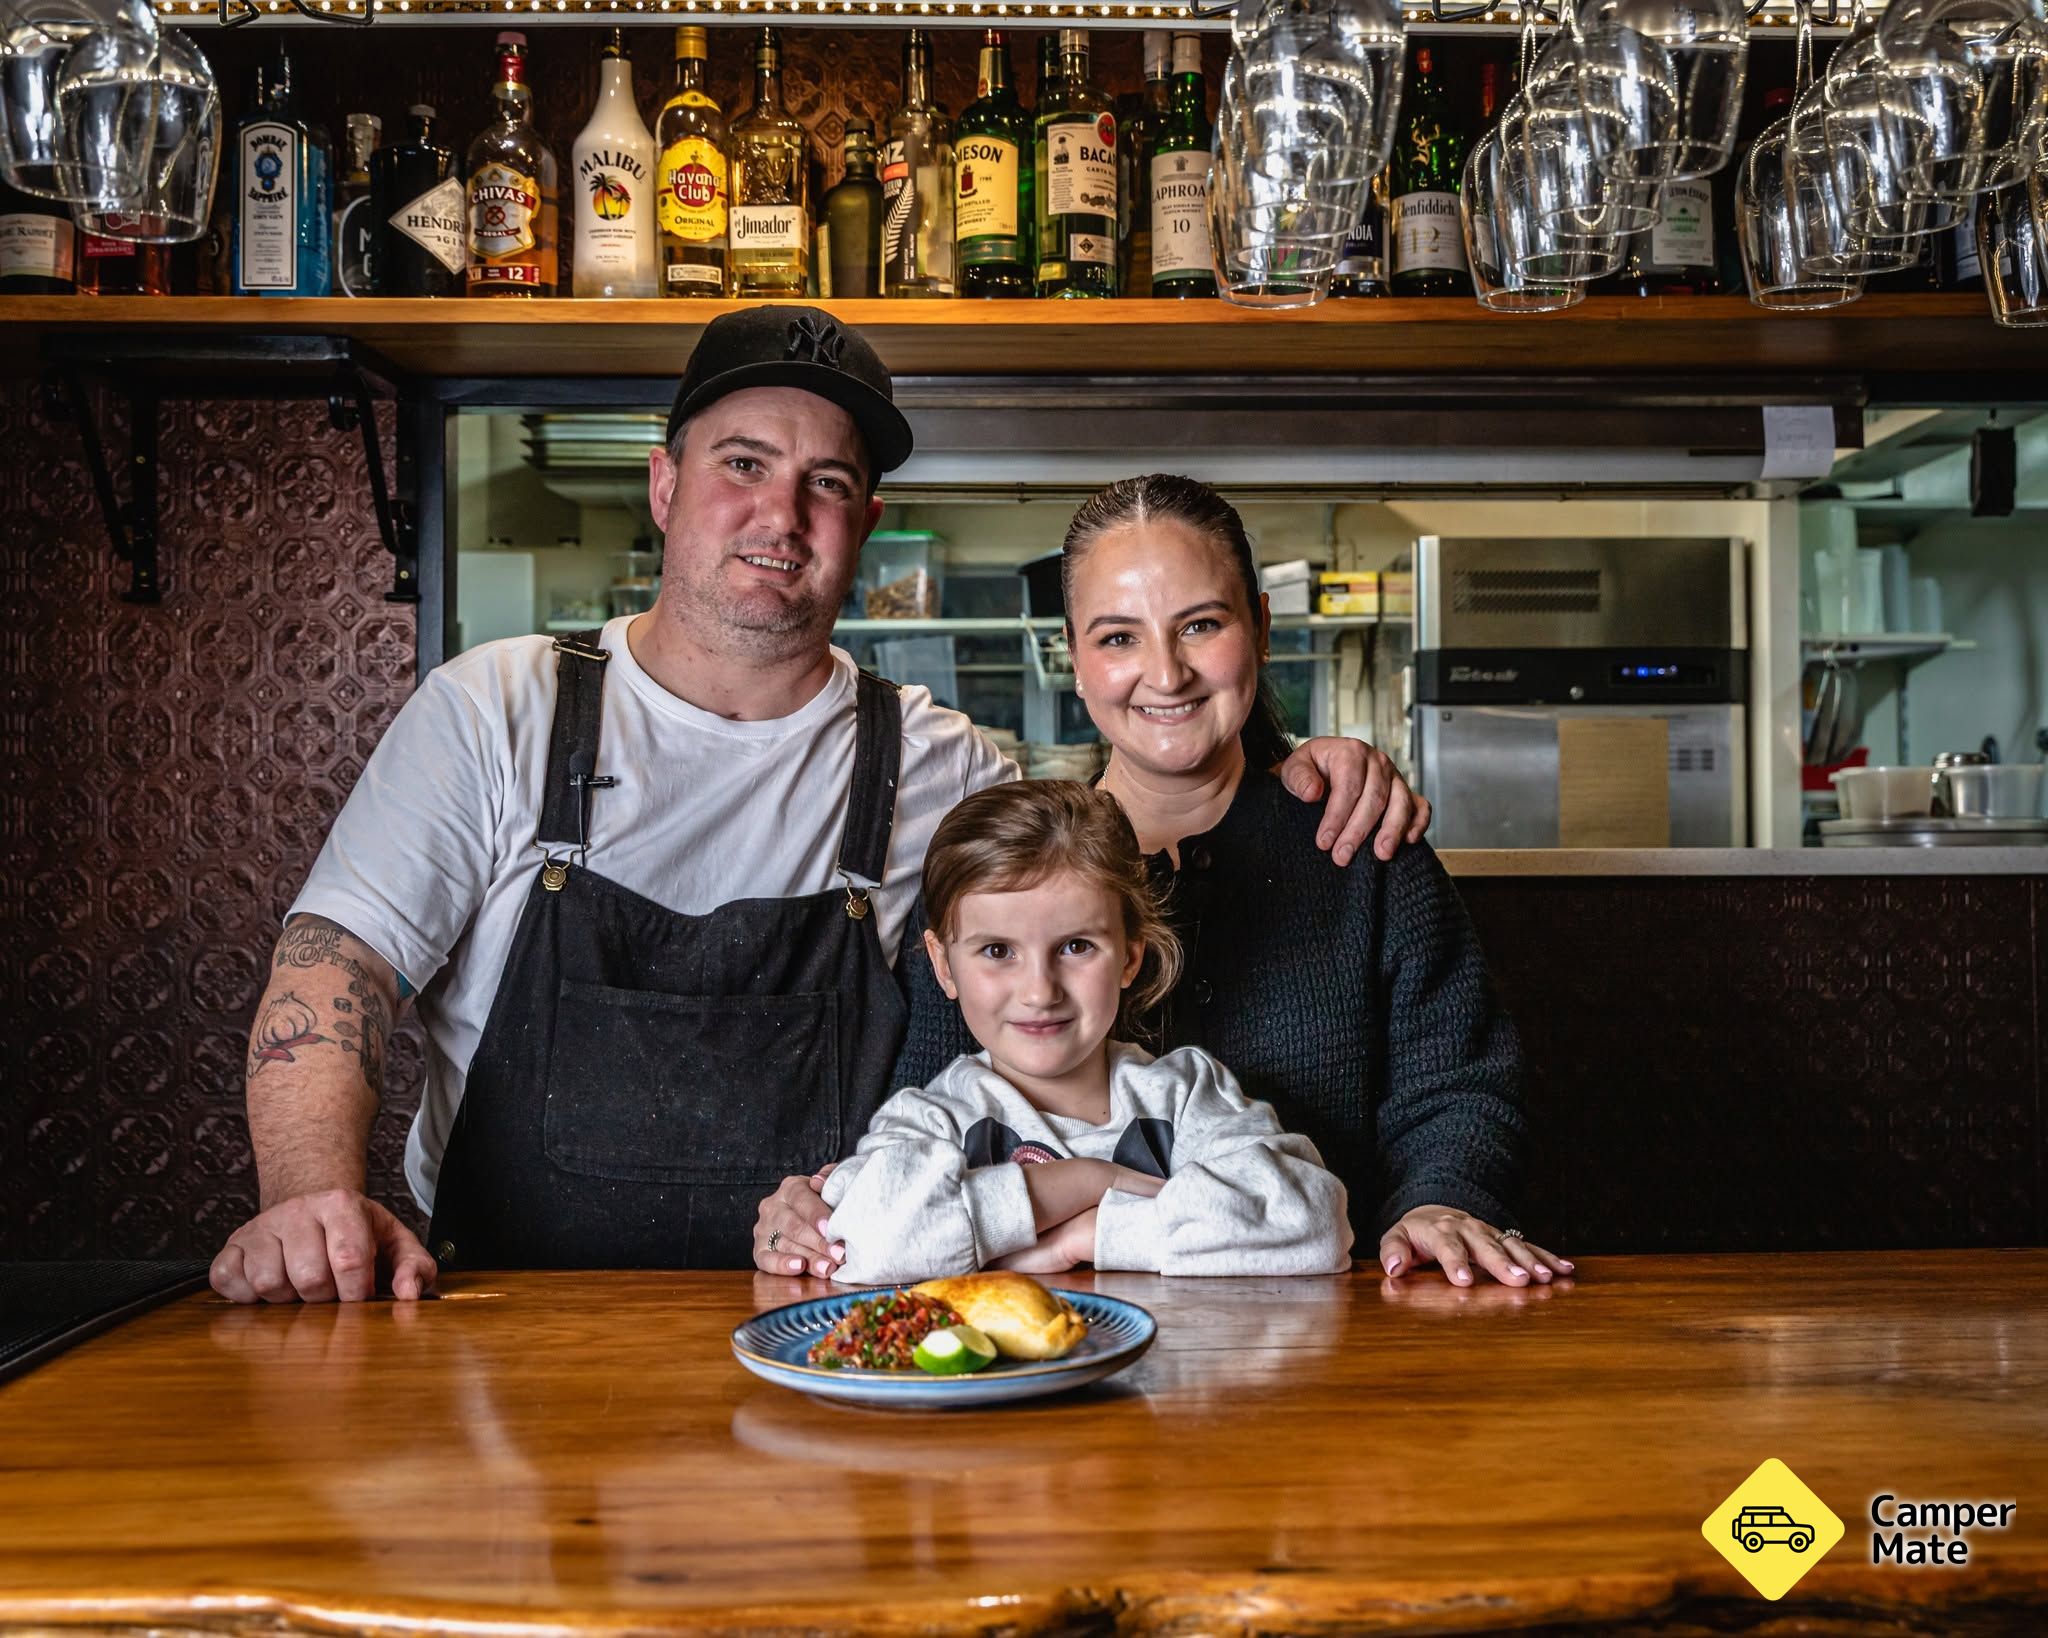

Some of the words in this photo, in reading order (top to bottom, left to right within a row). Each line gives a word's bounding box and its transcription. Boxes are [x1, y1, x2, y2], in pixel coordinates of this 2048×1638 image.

[250, 135, 288, 152] BOMBAY
[580, 150, 647, 182] MALIBU
[668, 169, 720, 187] Havana
[472, 186, 527, 204] CHIVAS
[678, 185, 711, 202] Club
[675, 215, 714, 227] ORIGINAL
[737, 214, 792, 239] Jimador
[1172, 219, 1190, 233] 10
[508, 267, 524, 280] 12
[785, 314, 845, 369] NY
